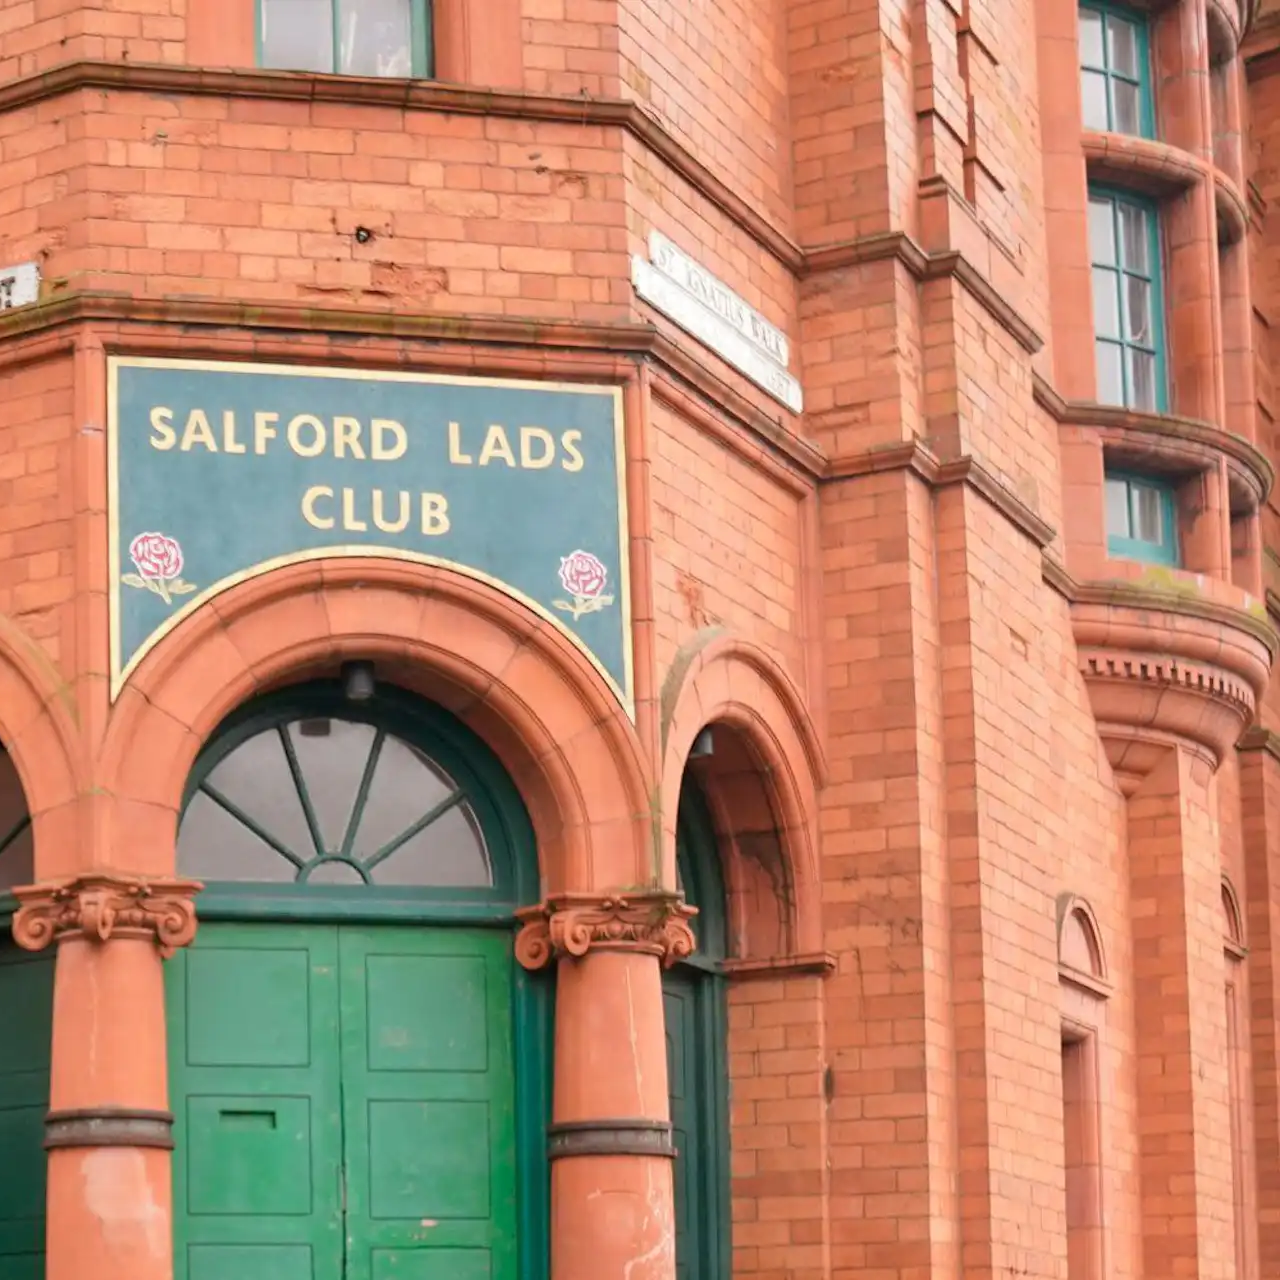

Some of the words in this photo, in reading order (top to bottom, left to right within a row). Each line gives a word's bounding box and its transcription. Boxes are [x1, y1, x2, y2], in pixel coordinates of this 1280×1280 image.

[148, 405, 408, 461] SALFORD
[448, 421, 585, 472] LADS
[301, 485, 451, 536] CLUB
